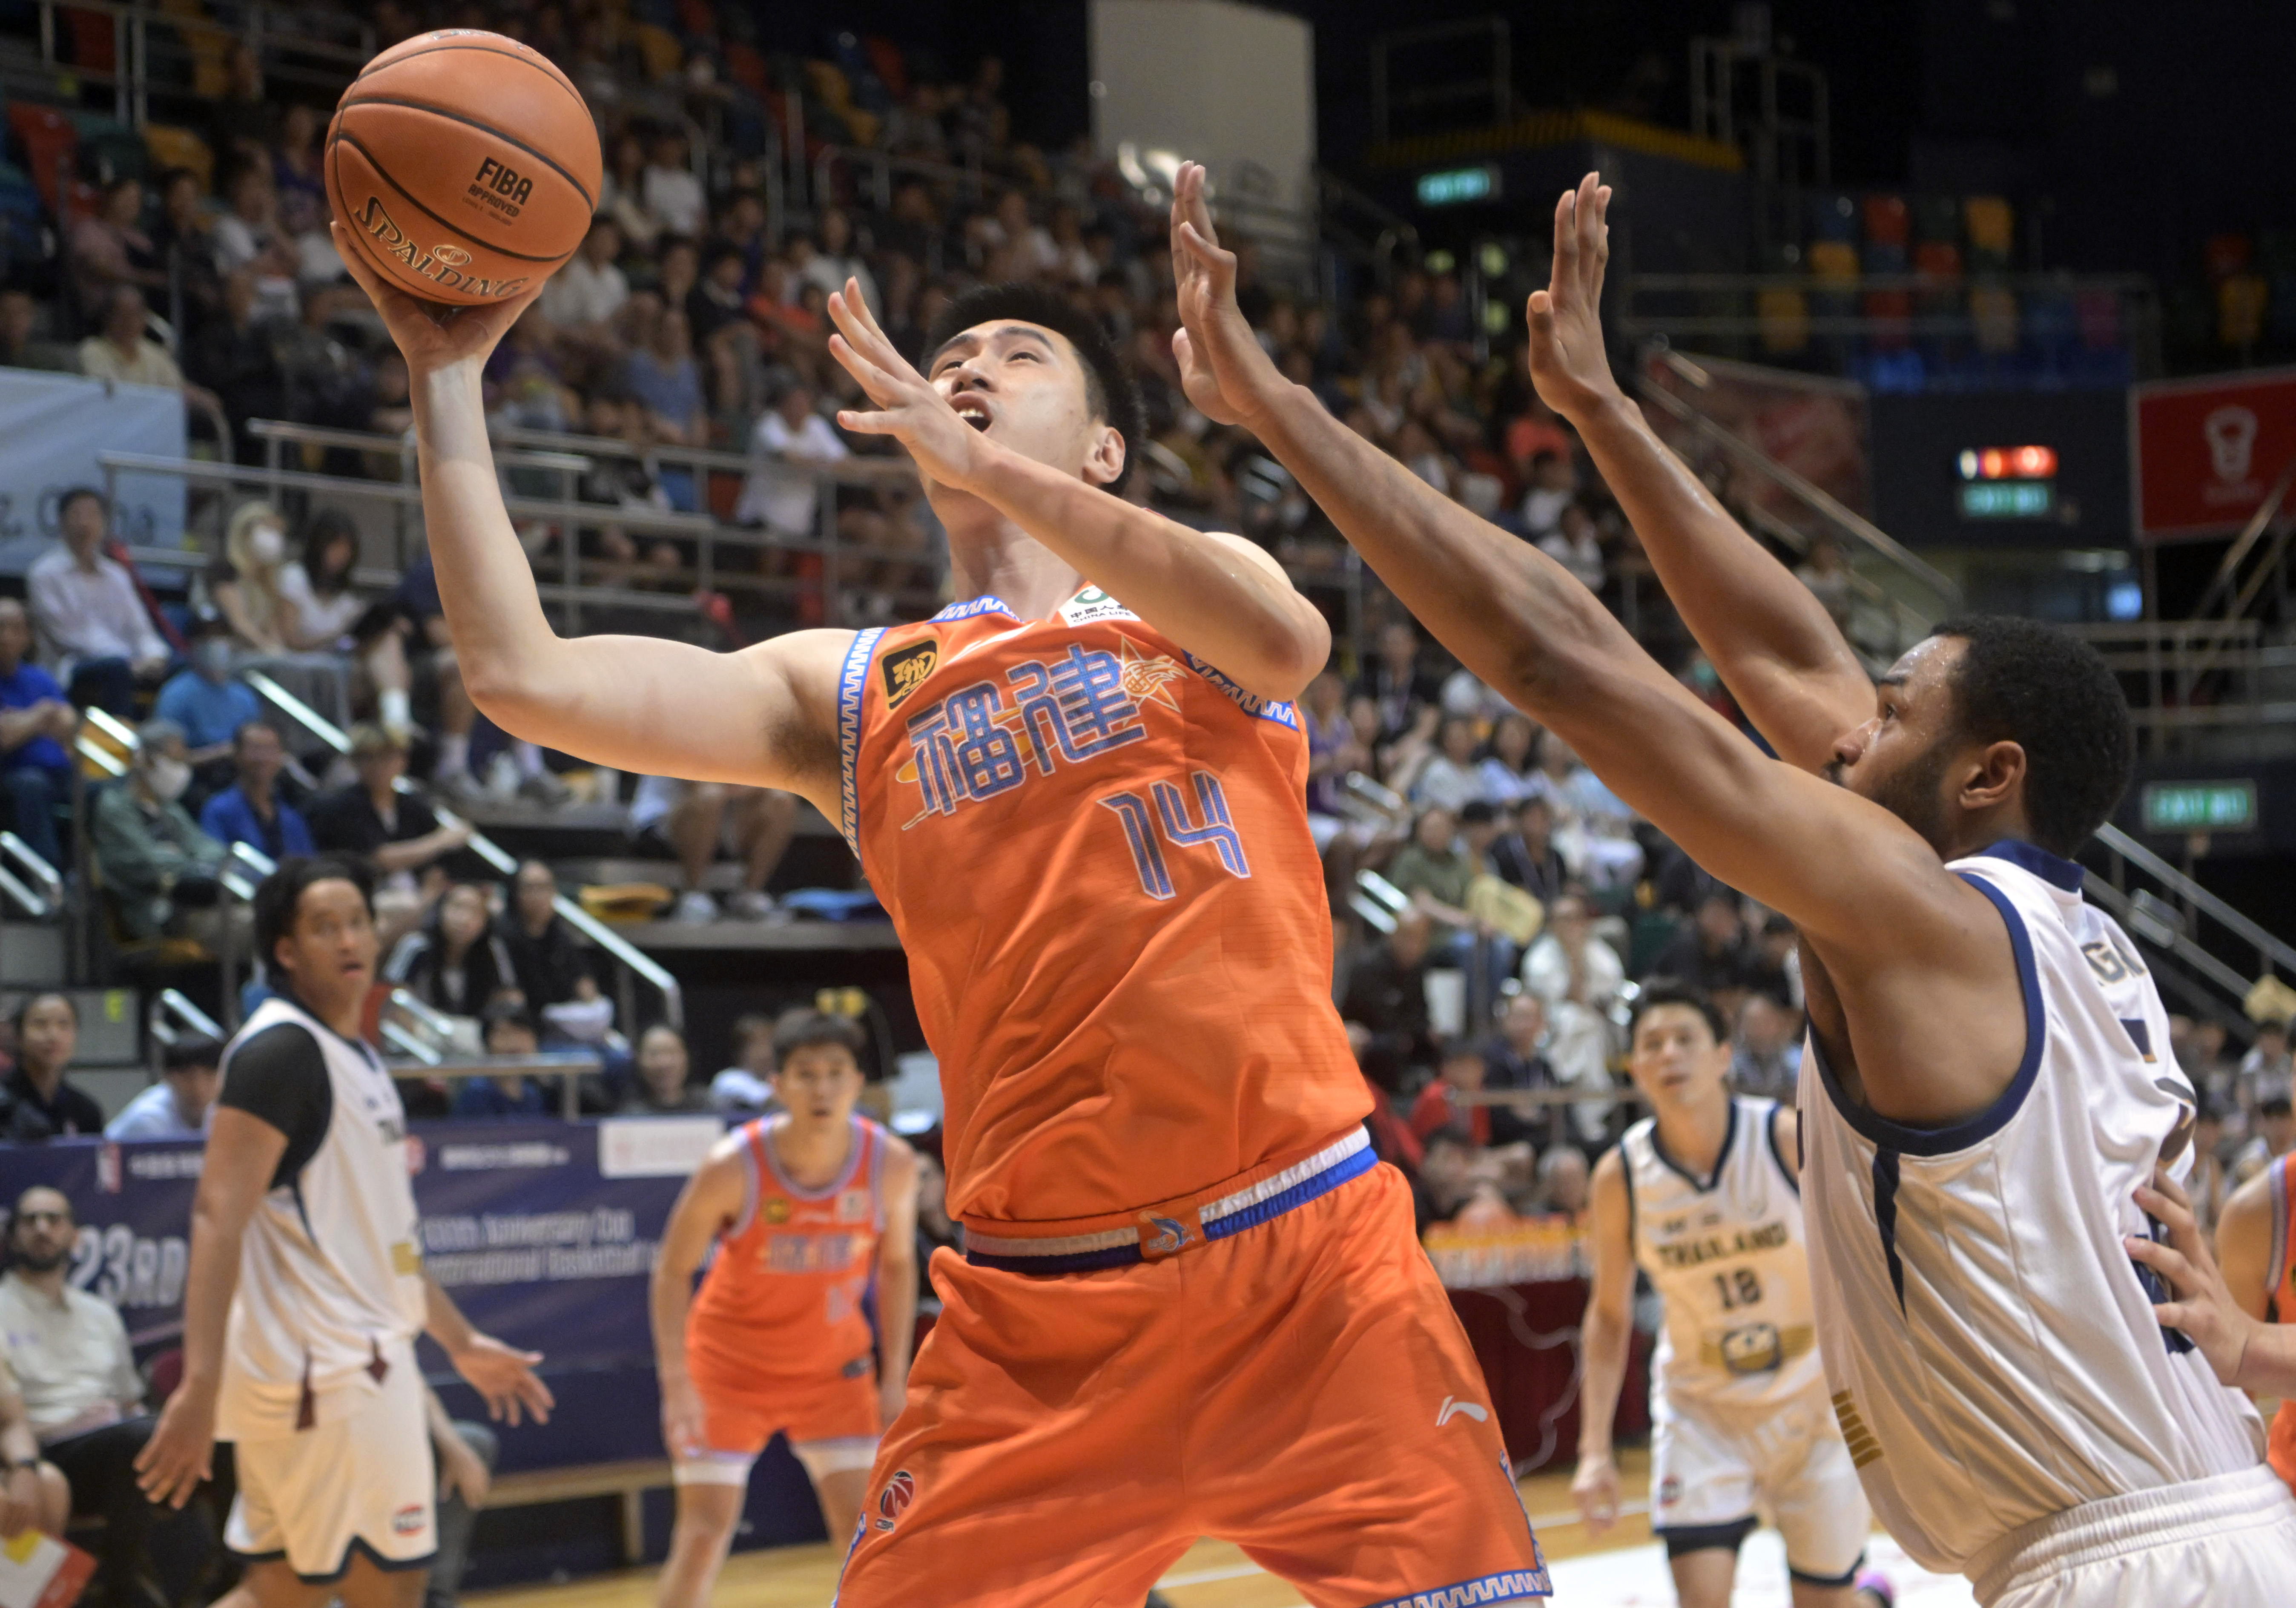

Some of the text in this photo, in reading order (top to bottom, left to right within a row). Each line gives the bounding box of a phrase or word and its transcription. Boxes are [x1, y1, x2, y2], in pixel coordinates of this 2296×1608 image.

[468, 184, 519, 217] APPROVED
[475, 156, 533, 206] FIBA
[354, 196, 529, 297] SPALDING
[1073, 613, 1106, 623] CHINA
[1096, 771, 1251, 900] 14
[1713, 1267, 1762, 1310] 18
